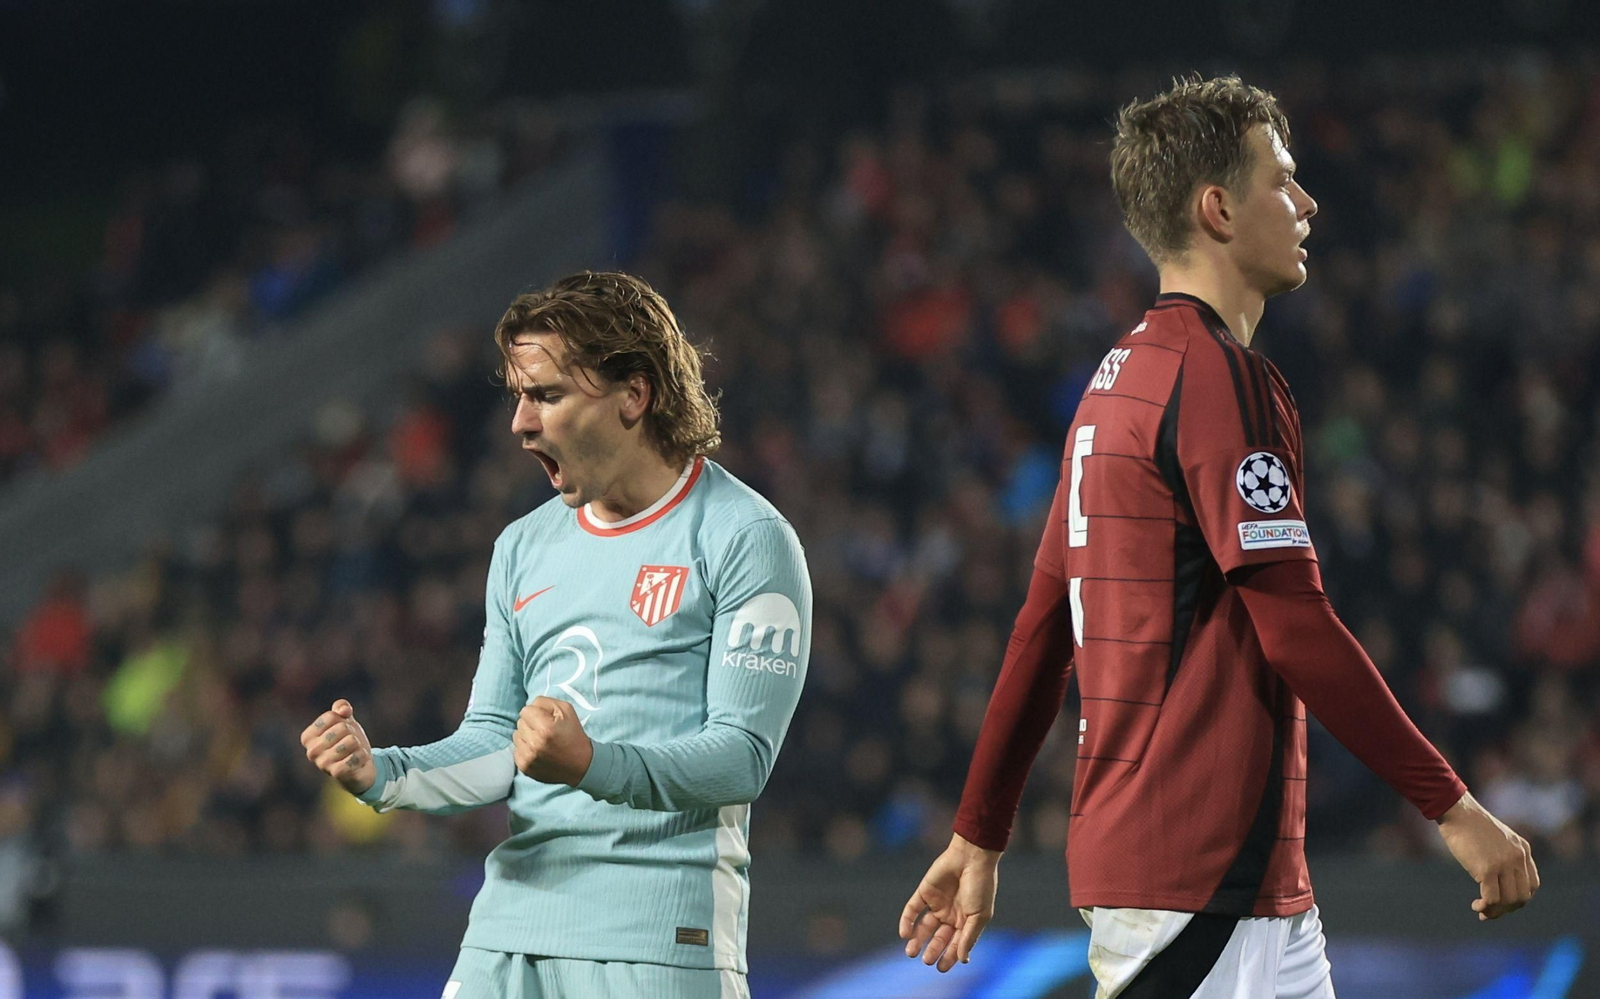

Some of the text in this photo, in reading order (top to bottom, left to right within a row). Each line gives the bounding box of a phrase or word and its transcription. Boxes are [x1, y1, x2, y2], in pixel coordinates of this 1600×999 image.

[1088, 347, 1132, 394] SS
[1242, 523, 1259, 531] UEFA
[1243, 528, 1308, 540] FOUNDATION
